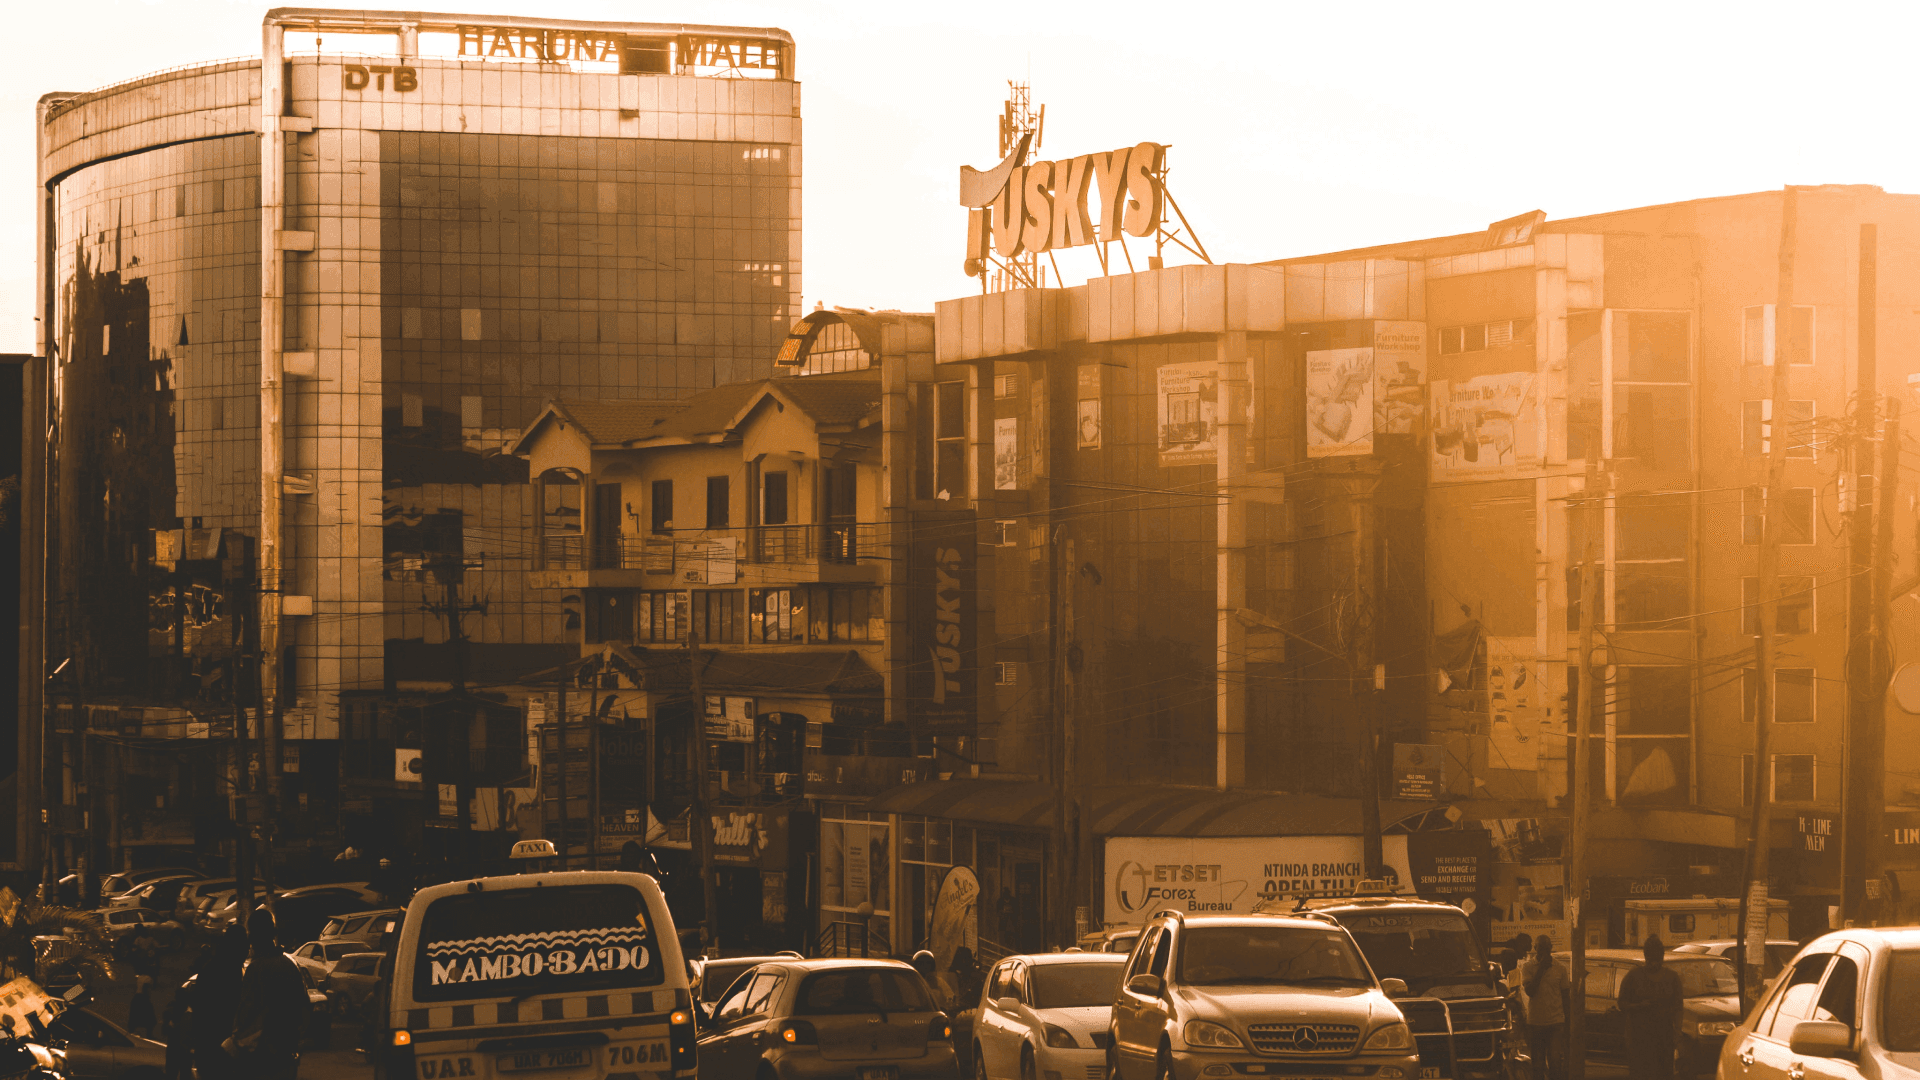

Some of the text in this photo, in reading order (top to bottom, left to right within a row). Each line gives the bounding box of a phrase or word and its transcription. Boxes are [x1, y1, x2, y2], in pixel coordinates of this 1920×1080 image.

[458, 26, 626, 63] HARUNA
[344, 64, 418, 92] DTB
[960, 131, 1164, 261] TUSKYS
[1377, 335, 1421, 343] Furniture
[1161, 377, 1190, 386] Furniture
[927, 546, 962, 704] TUSKYS
[602, 824, 639, 833] HEAVEN
[1799, 817, 1806, 832] K
[1813, 818, 1832, 836] LINE
[519, 843, 547, 854] TAXI
[1805, 835, 1825, 852] MEN
[1264, 863, 1309, 878] NTINDA
[1312, 862, 1361, 877] BRANCH
[1363, 882, 1384, 891] TAXI
[1420, 875, 1477, 884] SEND AND RECEIVE
[1630, 881, 1670, 894] Ecobank
[1144, 887, 1196, 902] Forex
[1188, 901, 1232, 912] Bureau
[430, 945, 650, 986] MAMBO-BADO
[515, 1051, 582, 1068] UAR 706M
[609, 1043, 669, 1066] 706M
[420, 1057, 476, 1080] UAR
